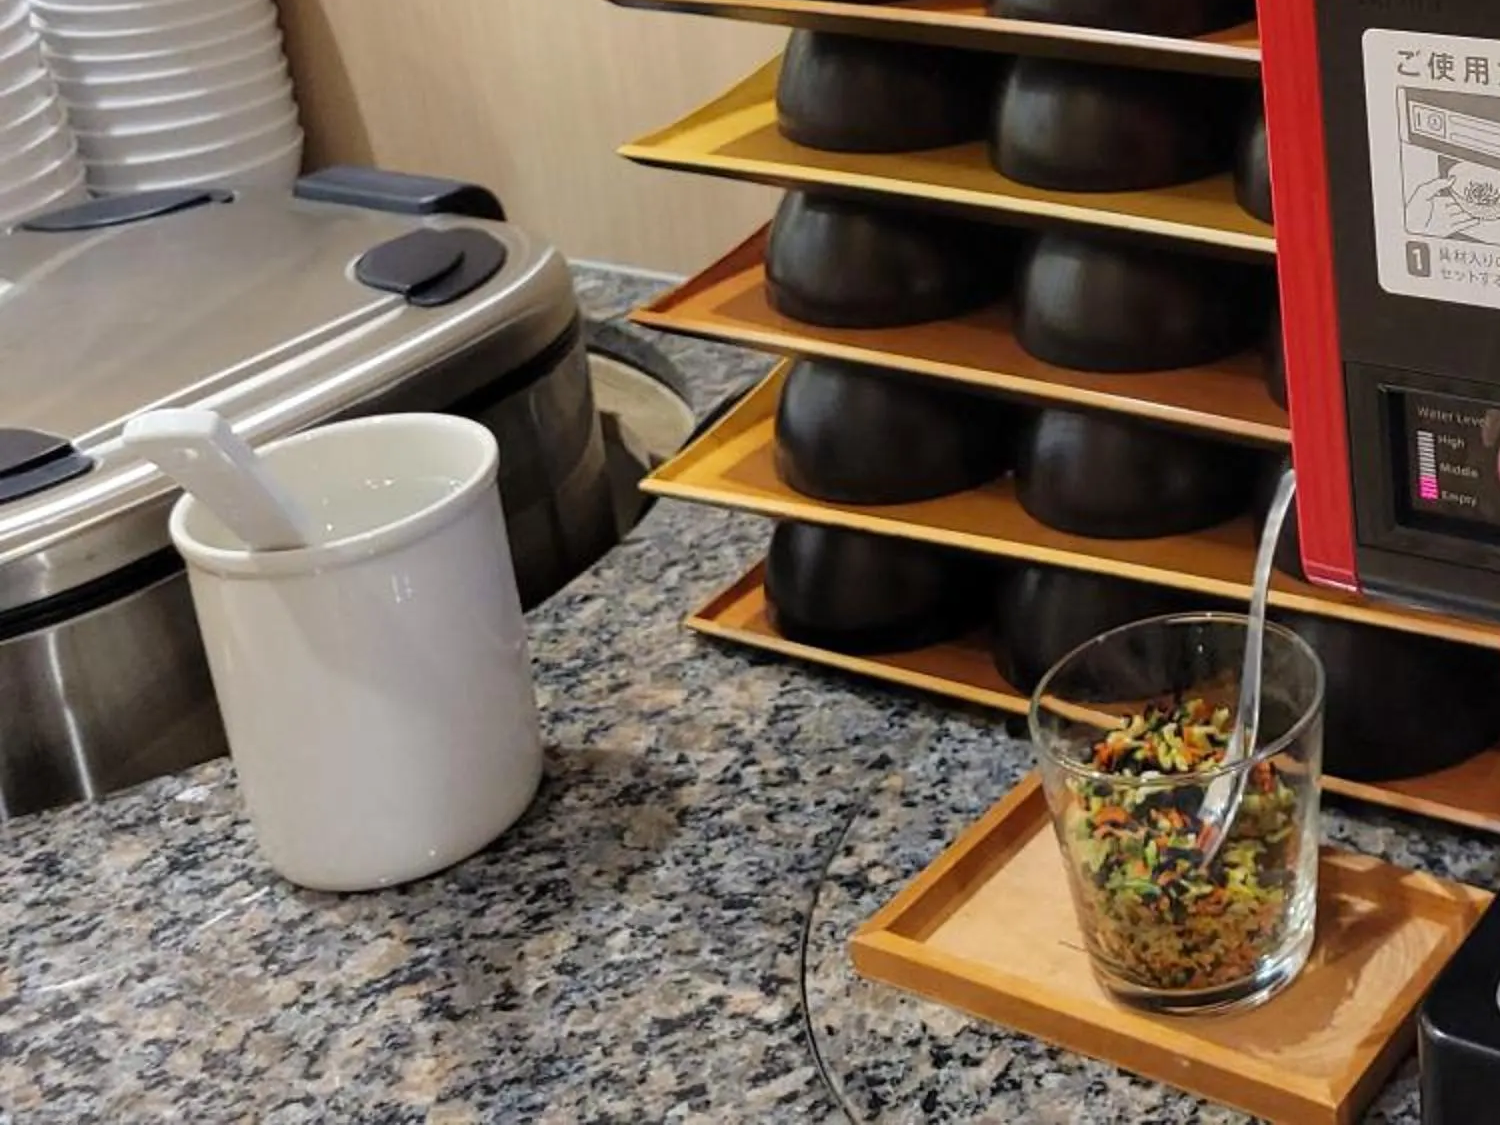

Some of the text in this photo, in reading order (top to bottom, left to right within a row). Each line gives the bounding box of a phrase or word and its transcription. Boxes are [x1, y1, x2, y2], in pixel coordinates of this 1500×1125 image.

[1417, 405, 1454, 423] Water
[1437, 433, 1465, 450] High
[1439, 461, 1480, 479] Middle
[1441, 489, 1478, 508] Empty
